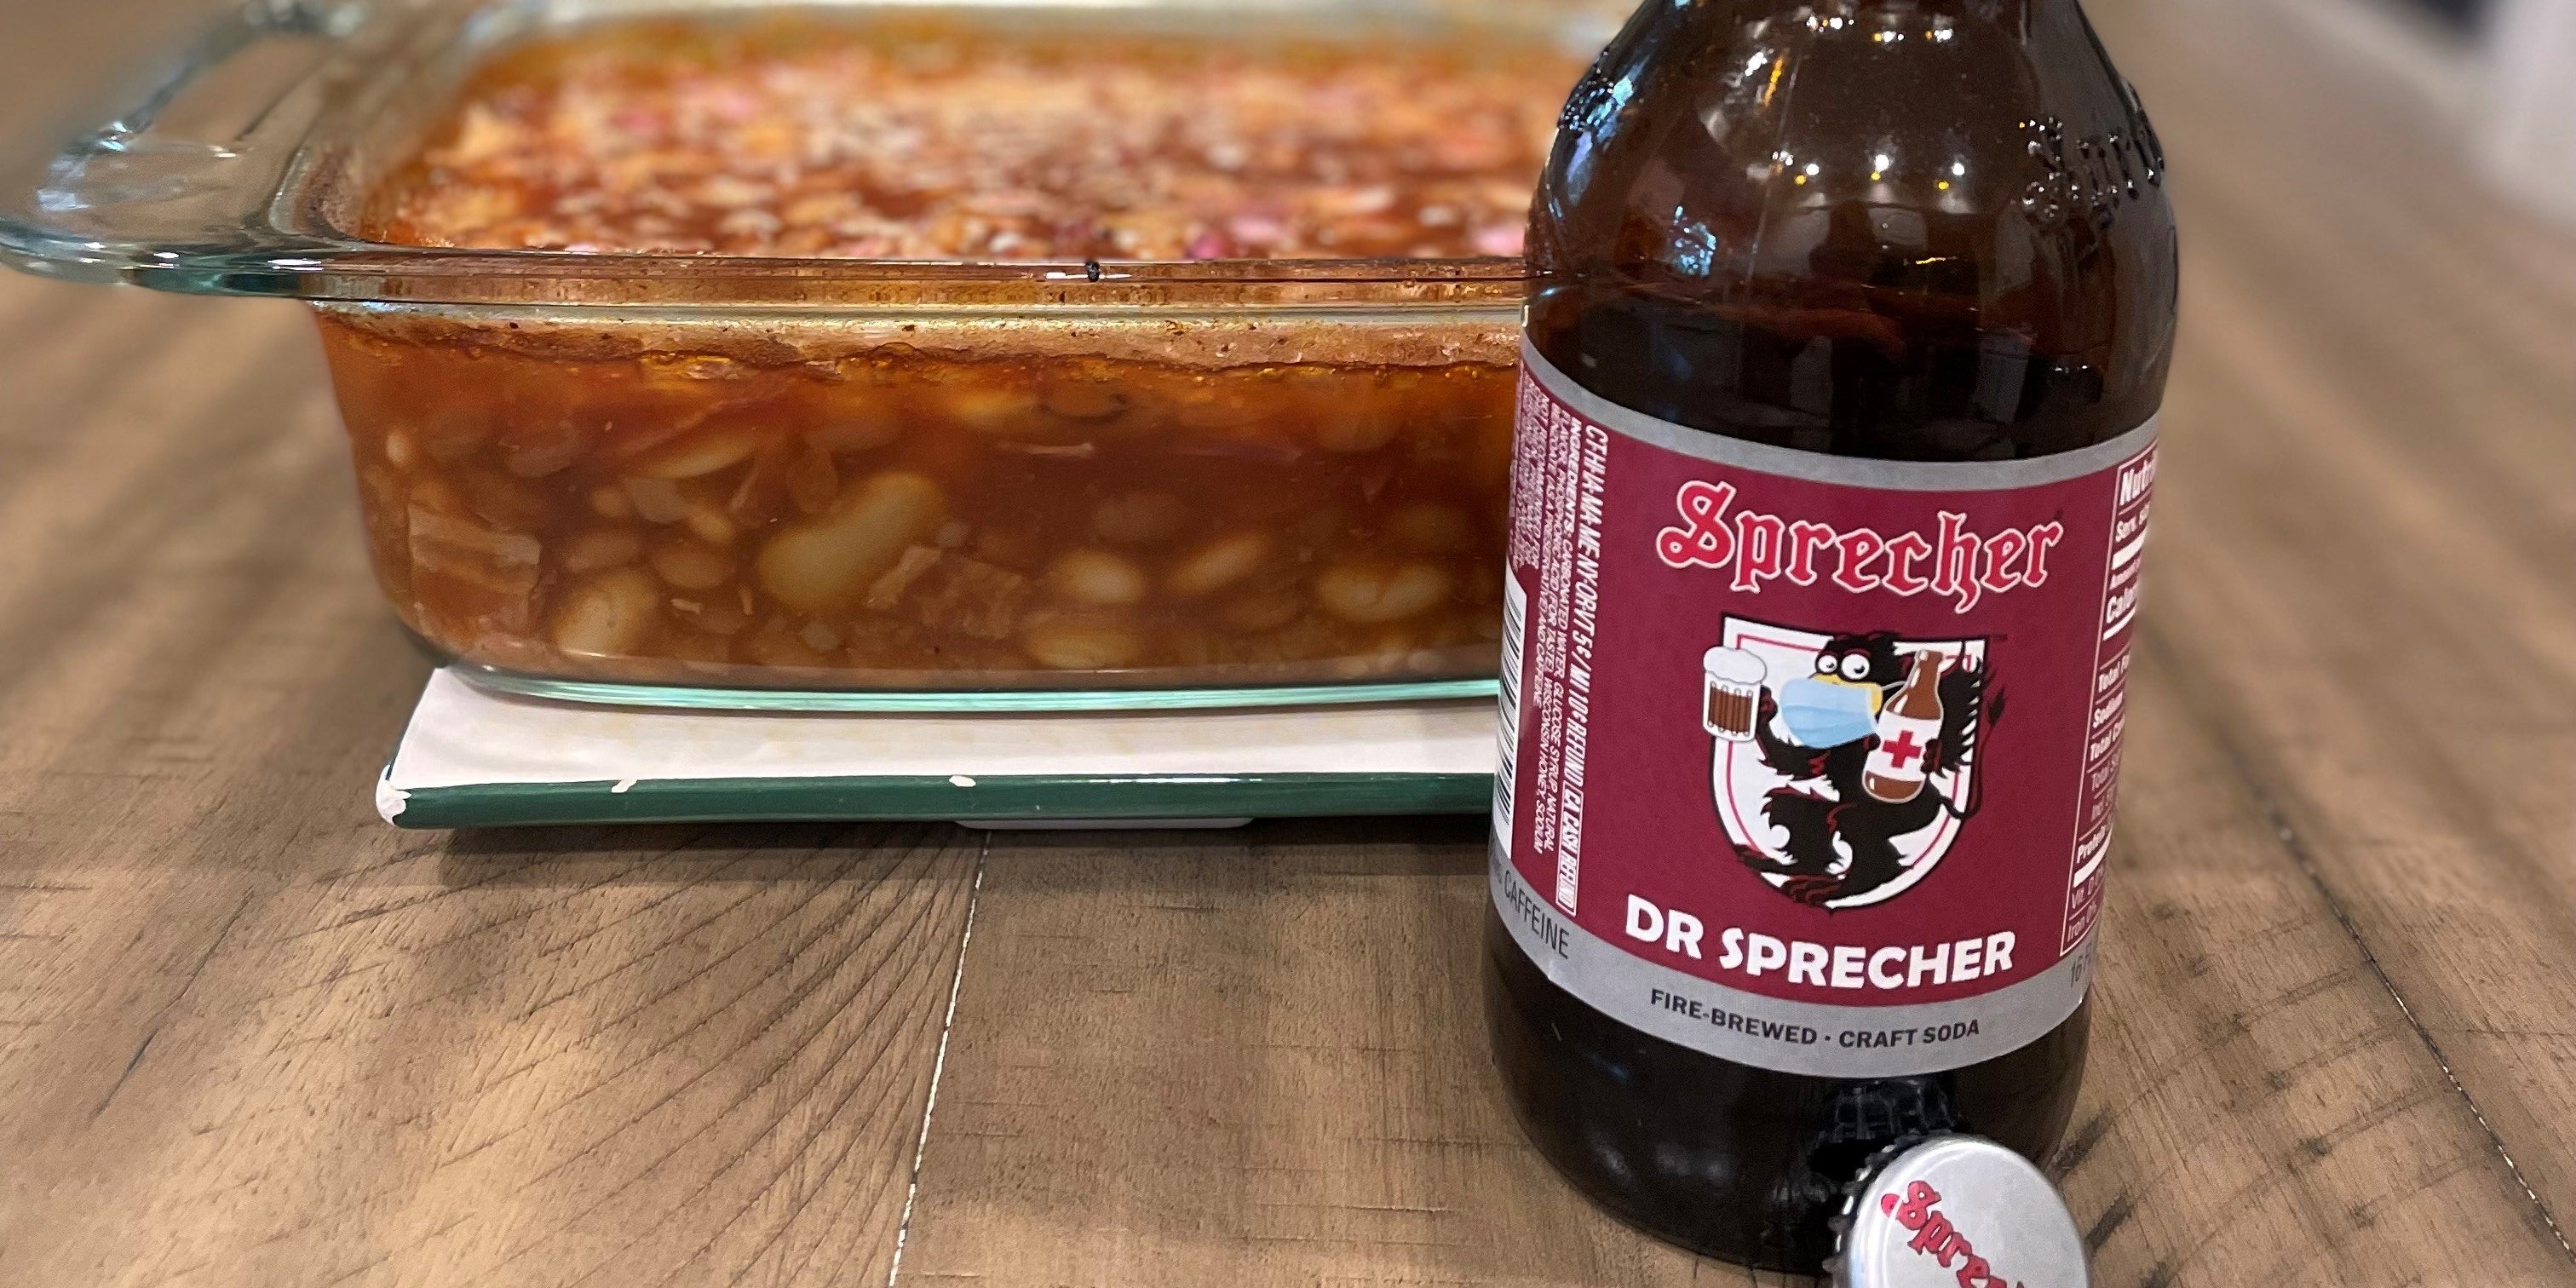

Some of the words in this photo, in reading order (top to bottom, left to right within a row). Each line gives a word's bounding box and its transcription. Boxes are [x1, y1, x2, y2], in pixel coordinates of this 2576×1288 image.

[1563, 417, 1582, 537] INGREDIENTS:
[1550, 557, 1560, 590] ACID
[1656, 480, 2063, 613] Sprecher
[1548, 590, 1557, 627] (FOR
[1557, 538, 1573, 630] CARBONATED
[1537, 612, 1546, 642] AND
[1573, 630, 1594, 659] 5¢
[1568, 689, 1589, 723] 10¢
[1569, 663, 1591, 693] MI
[1539, 676, 1552, 754] WISCONSIN
[1550, 681, 1564, 745] GLUCOSE
[1563, 717, 1586, 787] REFUND
[1532, 799, 1544, 854] SODIUM
[1544, 793, 1556, 852] NATURAL
[1563, 788, 1581, 812] CA
[1561, 810, 1579, 854] CASH
[1558, 849, 1577, 908] REFUND
[1504, 870, 1569, 959] CAFFEINE
[1625, 894, 1704, 959] DR
[1720, 927, 2016, 990] SPRECHER
[1650, 989, 1817, 1045] FIRE-BREWED
[1839, 1028, 1918, 1049] CRAFT
[1923, 1020, 1981, 1044] SODA
